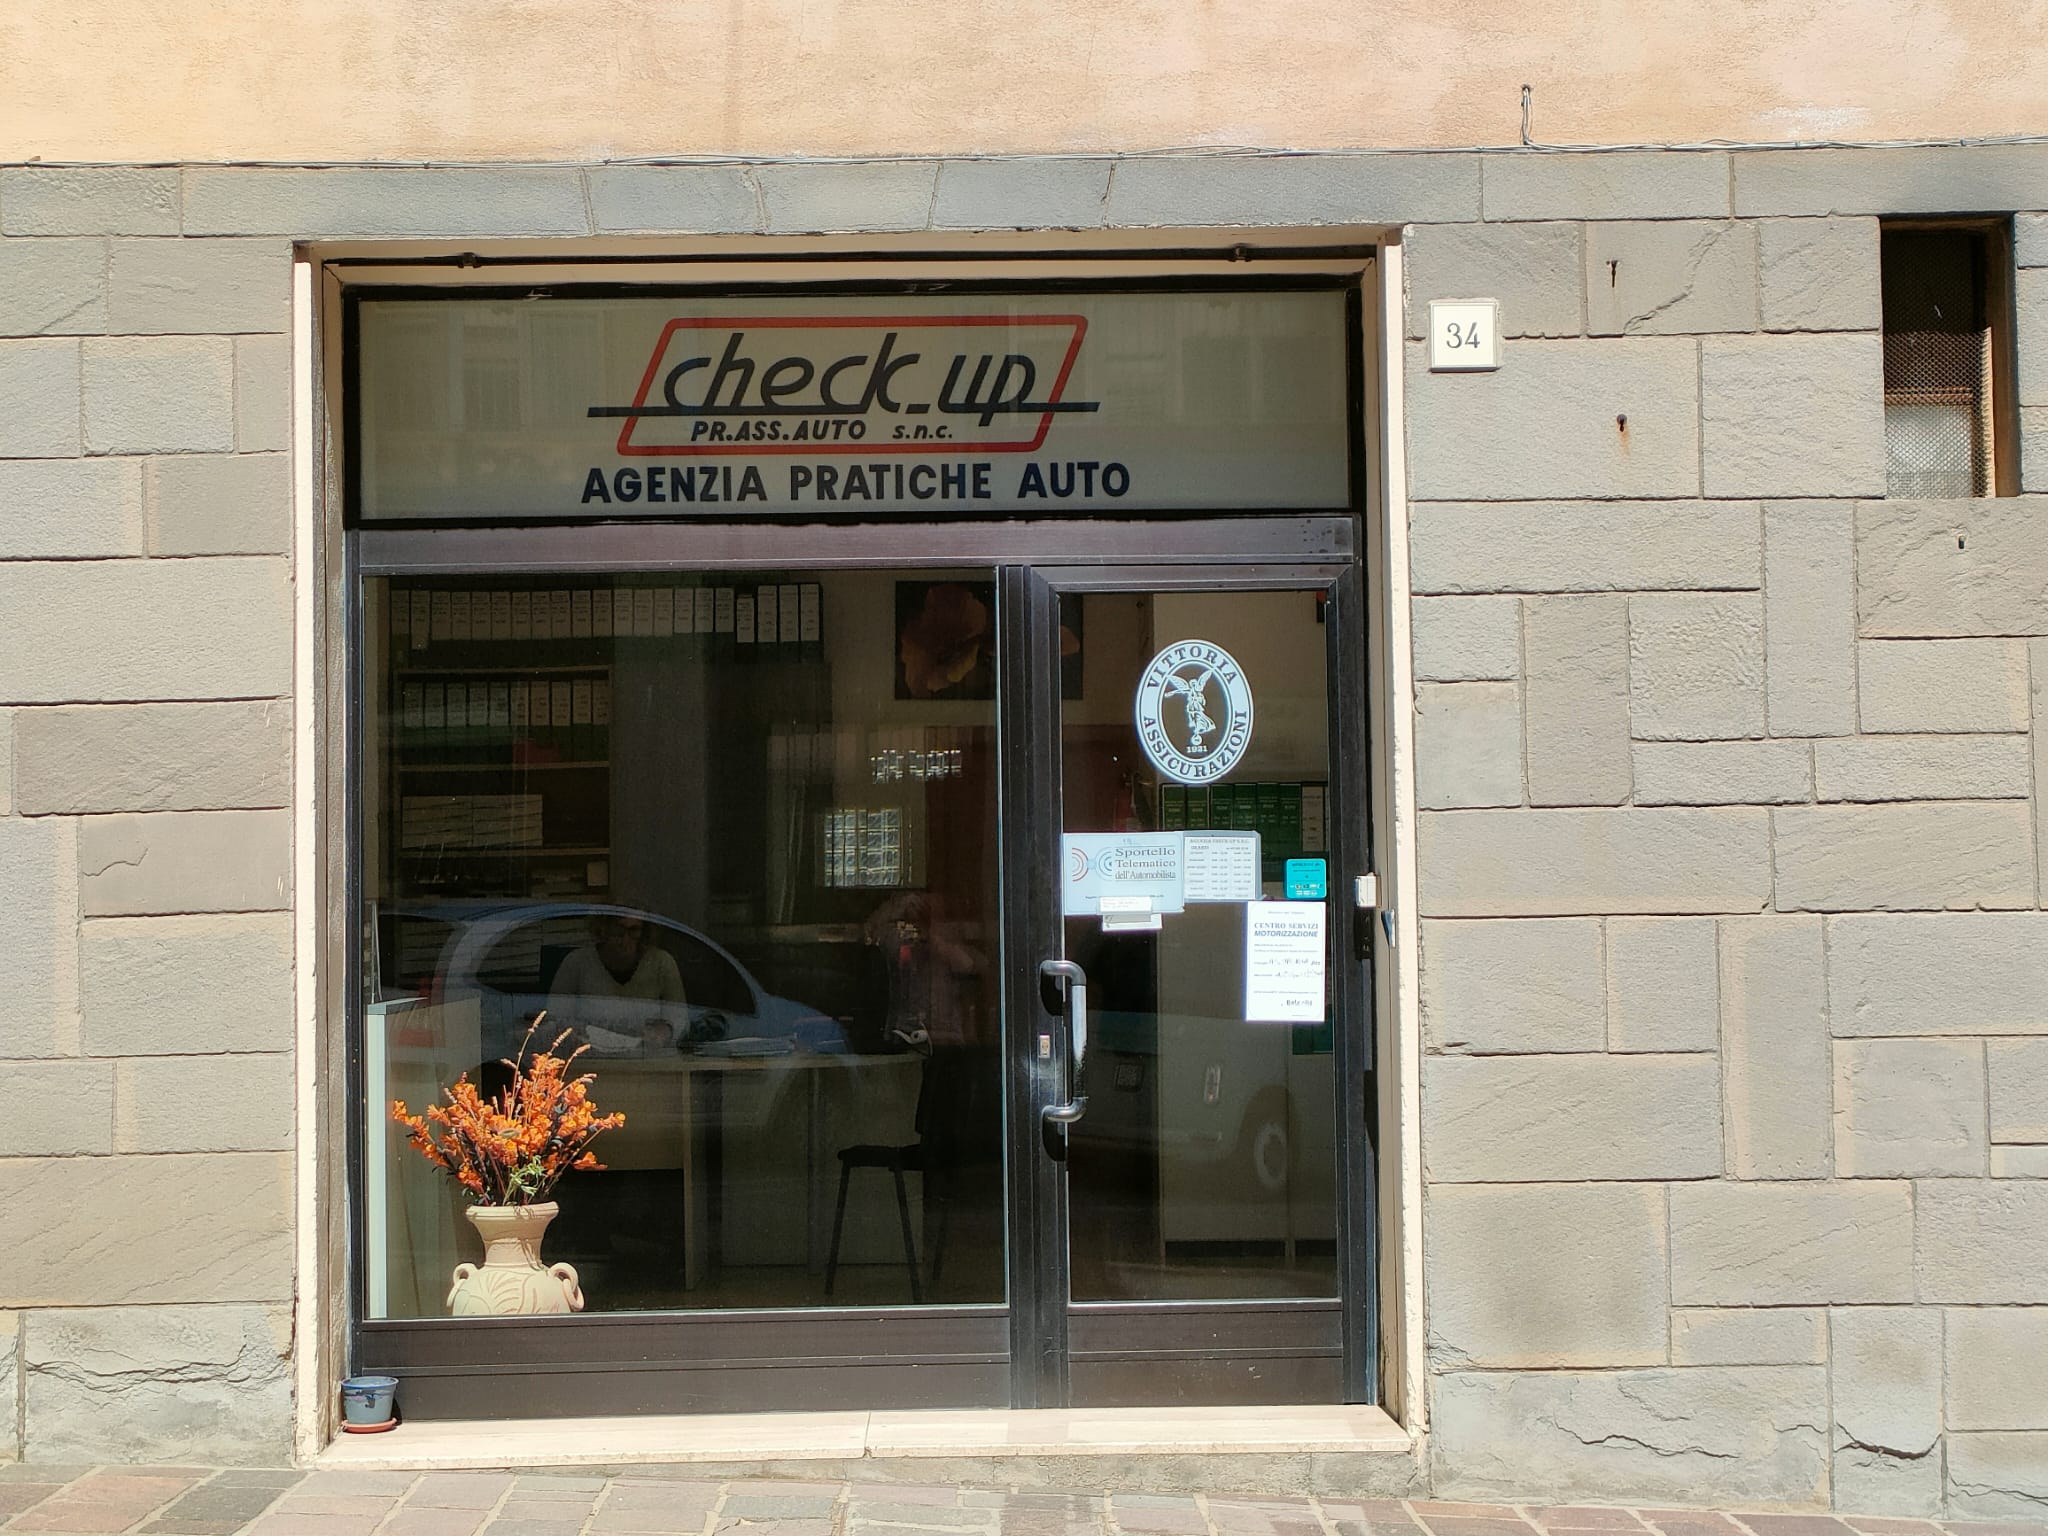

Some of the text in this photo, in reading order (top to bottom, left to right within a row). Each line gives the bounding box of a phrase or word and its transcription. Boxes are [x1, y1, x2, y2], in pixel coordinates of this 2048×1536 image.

[1446, 322, 1480, 349] 34
[892, 424, 954, 440] s.n.c.
[581, 461, 1131, 504] AGENZIA PRATICHE AUTO
[1147, 645, 1238, 689] VITTORIA
[1143, 710, 1247, 778] ASSICURAZIONI
[1115, 847, 1176, 858] Sportello
[1115, 859, 1176, 868] Telematico
[1115, 870, 1176, 880] dell'Automobilista
[1288, 922, 1319, 930] SERVIZI
[1254, 930, 1319, 938] MOTORIZZAZIONE
